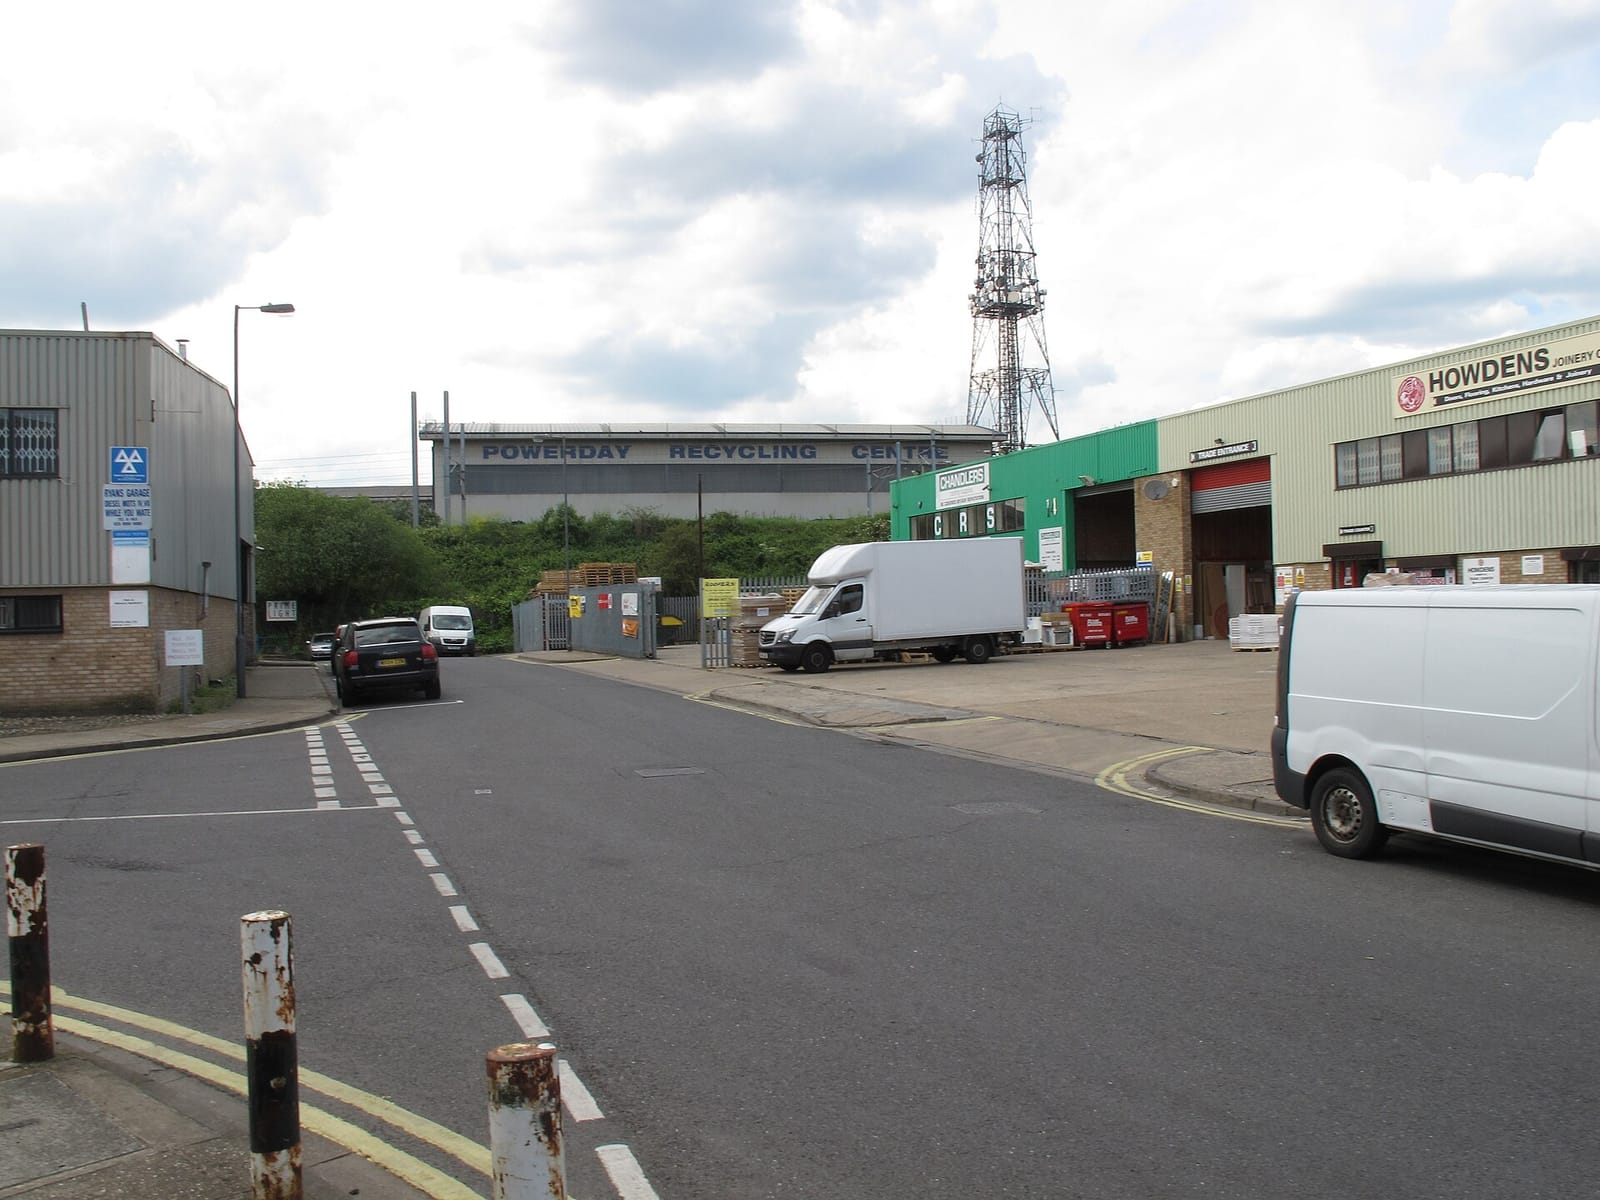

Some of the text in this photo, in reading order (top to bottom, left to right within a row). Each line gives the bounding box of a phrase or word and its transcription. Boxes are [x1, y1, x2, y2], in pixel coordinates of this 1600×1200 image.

[1429, 348, 1550, 393] HOWDENS
[1552, 350, 1594, 368] JOINERY
[1565, 368, 1593, 379] Joinery
[482, 445, 949, 460] POWERDAY RECYCLING CENTRE
[940, 468, 984, 490] CHANDLERS
[105, 488, 150, 498] RYANS GARAGE
[123, 509, 135, 517] YOU
[934, 507, 995, 536] C R S
